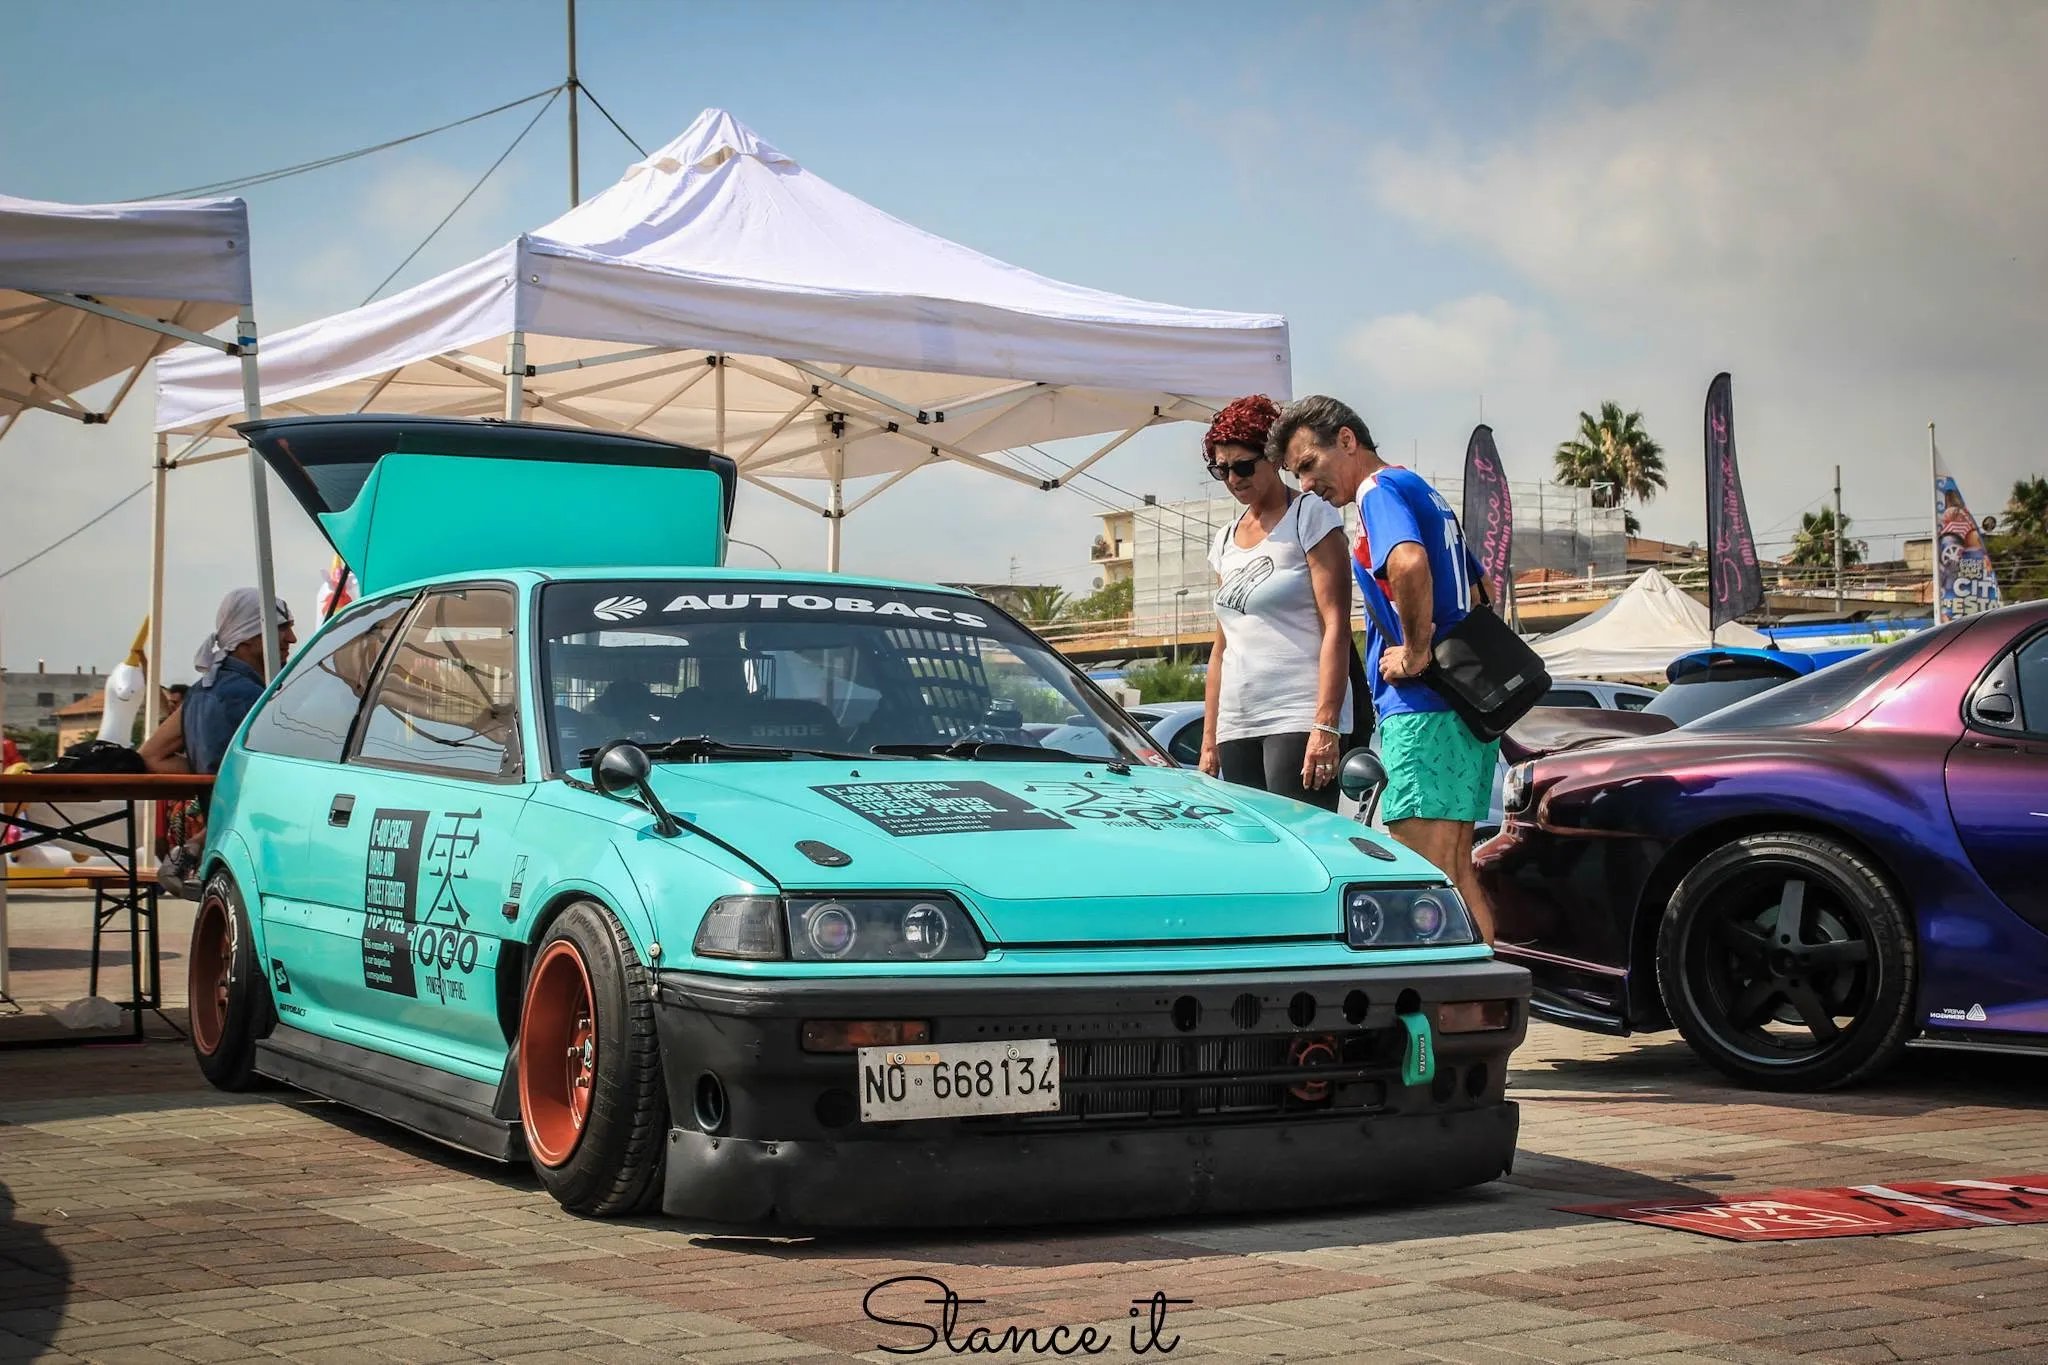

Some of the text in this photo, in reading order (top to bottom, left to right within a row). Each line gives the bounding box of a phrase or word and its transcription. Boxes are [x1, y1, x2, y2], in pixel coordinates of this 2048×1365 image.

[1480, 491, 1500, 577] ance
[1494, 525, 1511, 571] italian
[661, 594, 989, 629] AUTOBACS
[823, 782, 960, 796] 0-400 SPECIAL
[837, 791, 932, 803] DRAG AND
[852, 797, 991, 810] STREET FIGHTER
[865, 804, 1009, 817] TOP FUEL
[388, 819, 413, 849] SPECIAL
[367, 878, 386, 905] STREET
[366, 906, 406, 934] TOP FUEL
[865, 1057, 1055, 1103] NO 668134
